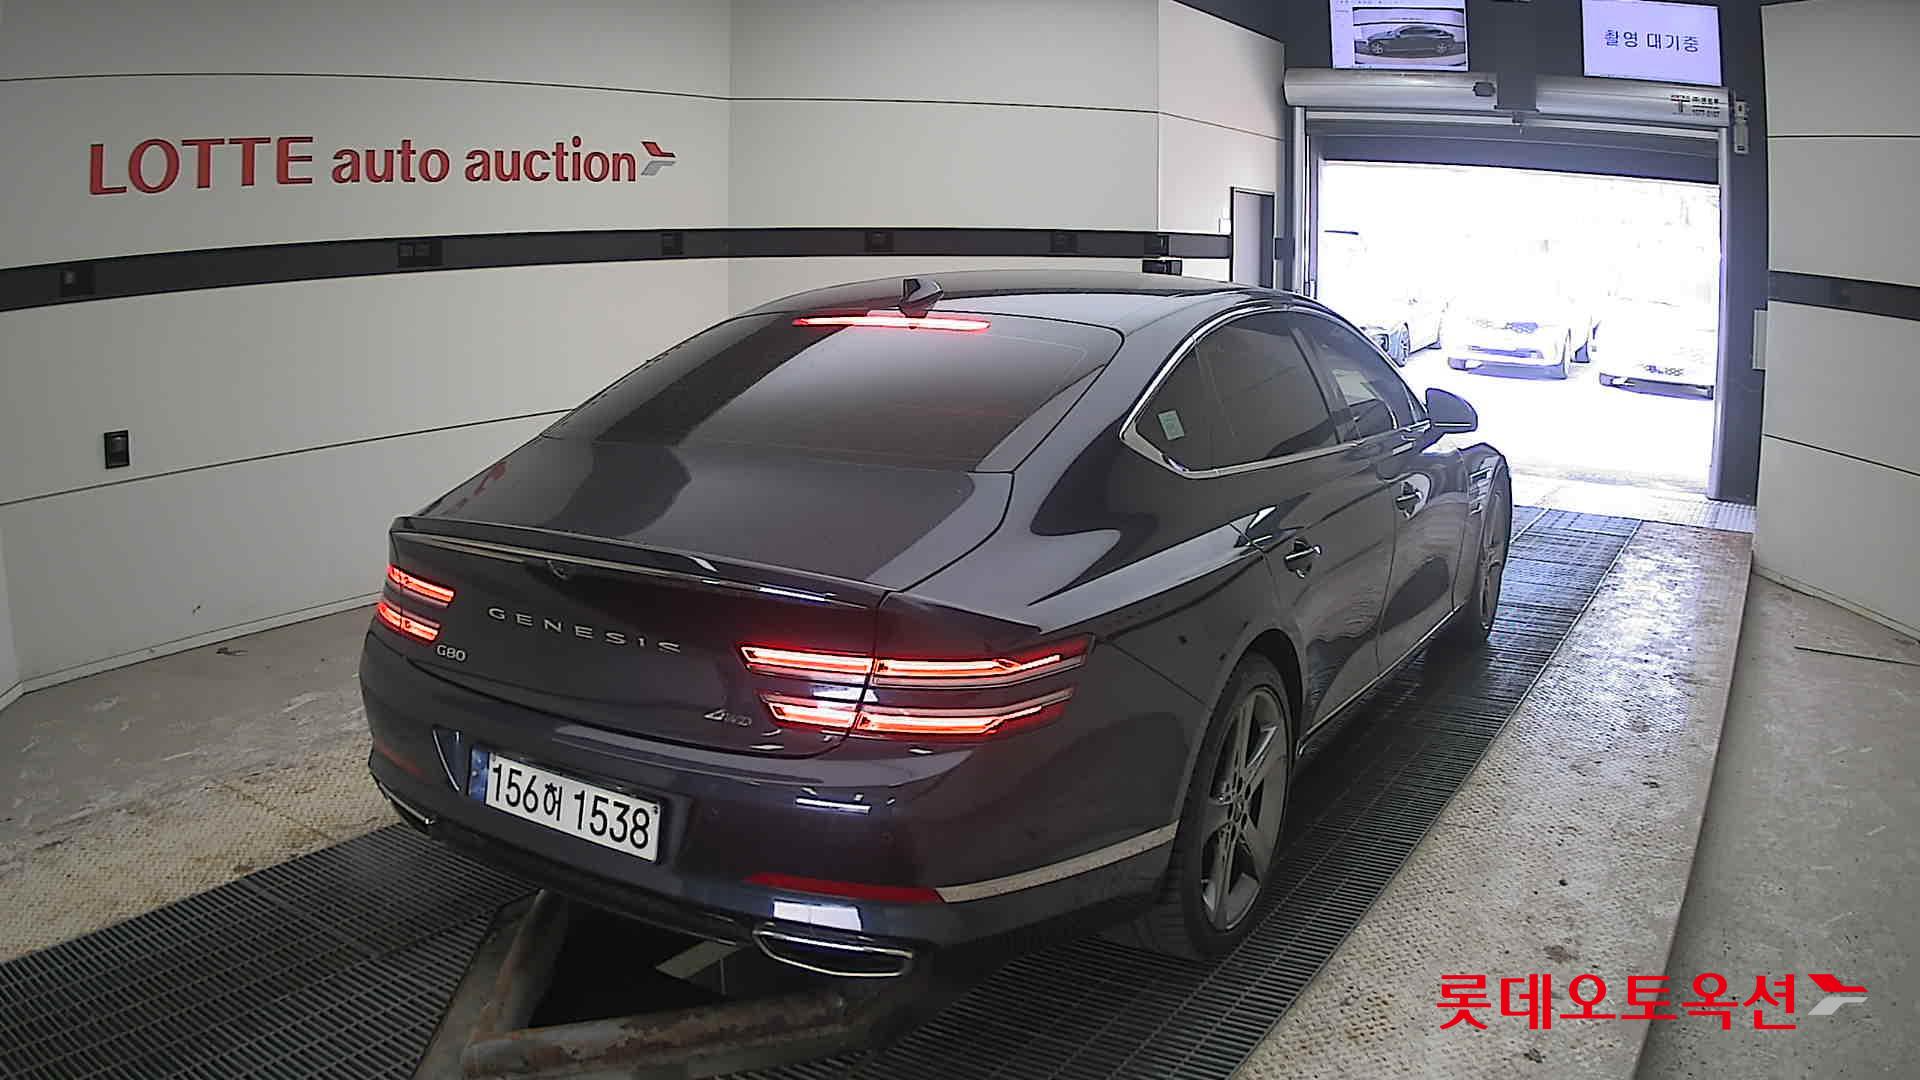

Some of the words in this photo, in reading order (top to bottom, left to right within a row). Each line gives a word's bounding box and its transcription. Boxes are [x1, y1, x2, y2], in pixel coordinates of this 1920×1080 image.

[1646, 33, 1699, 52] 대기중
[88, 136, 314, 195] LOTTE
[331, 139, 450, 184] auto
[464, 135, 638, 183] auction
[436, 643, 467, 663] G80
[487, 606, 682, 654] GENESIS
[492, 763, 563, 822] 156허
[574, 789, 650, 849] 1538
